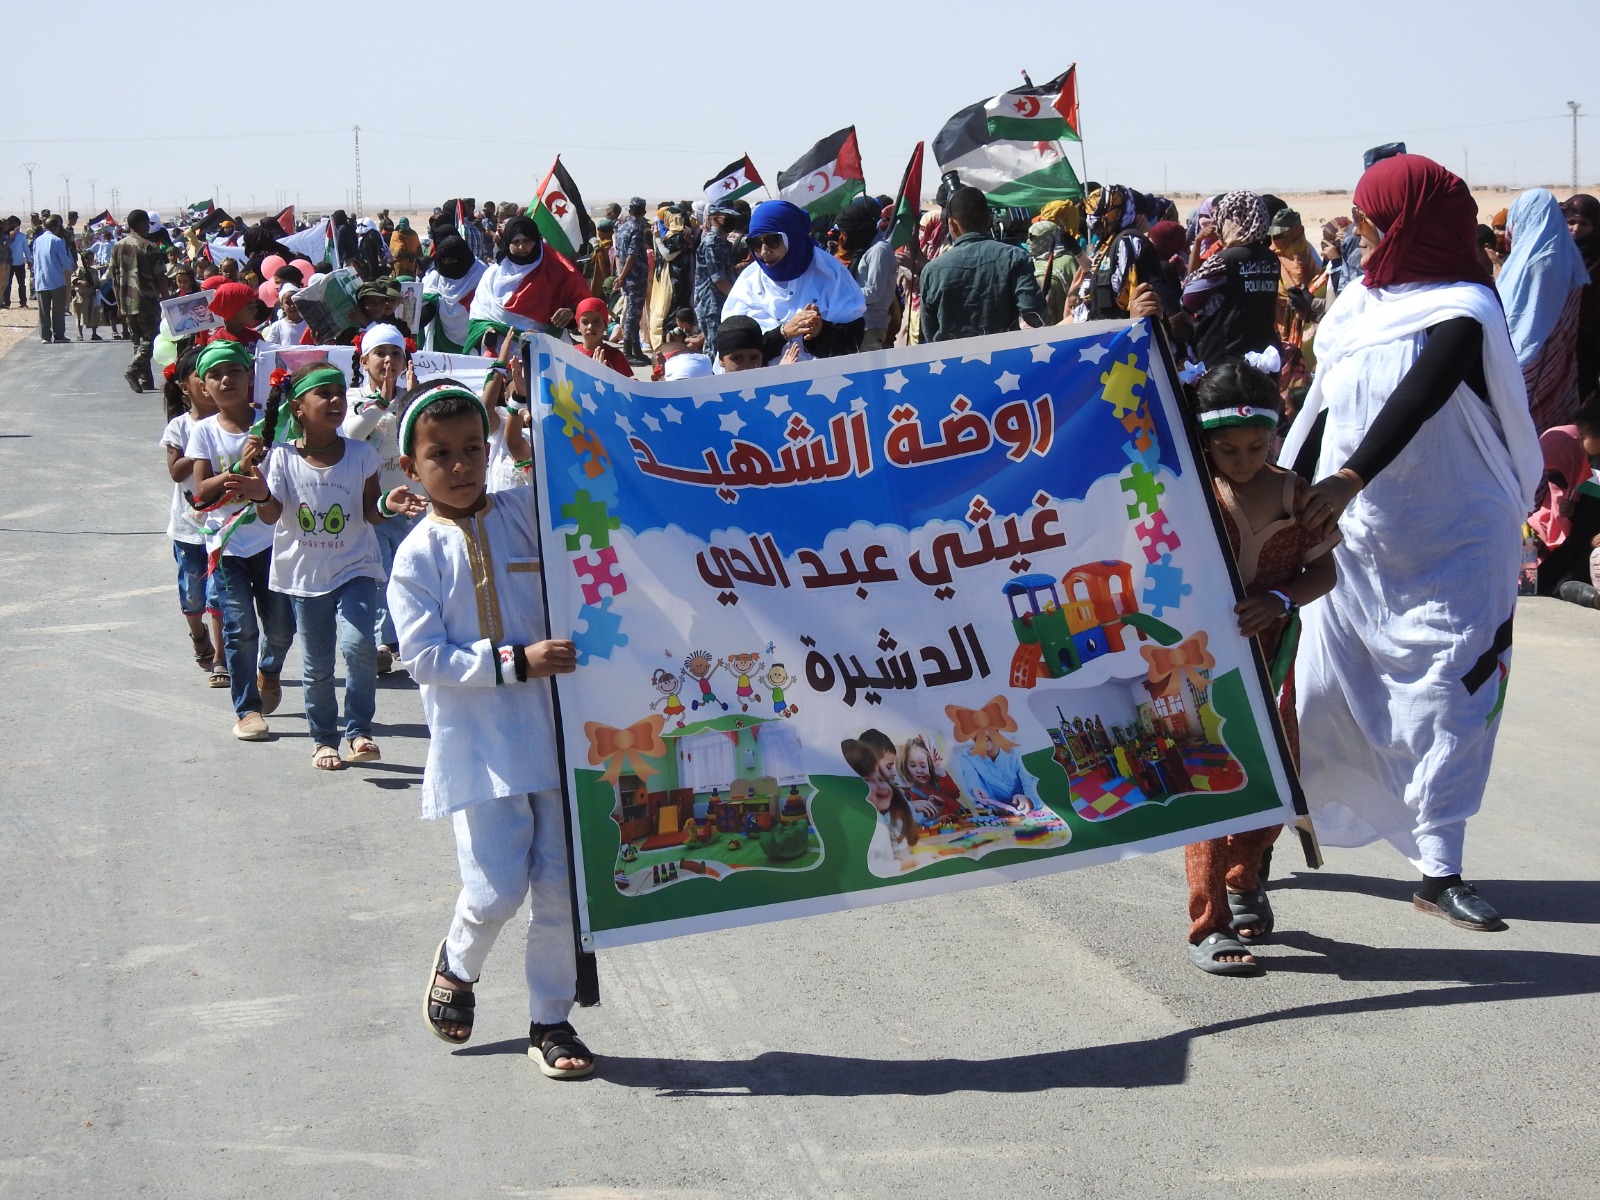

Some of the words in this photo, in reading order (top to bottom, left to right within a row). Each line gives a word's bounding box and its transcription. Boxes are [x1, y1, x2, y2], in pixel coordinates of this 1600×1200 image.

[628, 412, 872, 502] الشهيد
[886, 395, 1053, 464] روضة
[696, 533, 793, 607] الحي
[797, 544, 899, 600] عبد
[908, 491, 1068, 602] غيثي
[799, 622, 992, 707] الدشيرة
